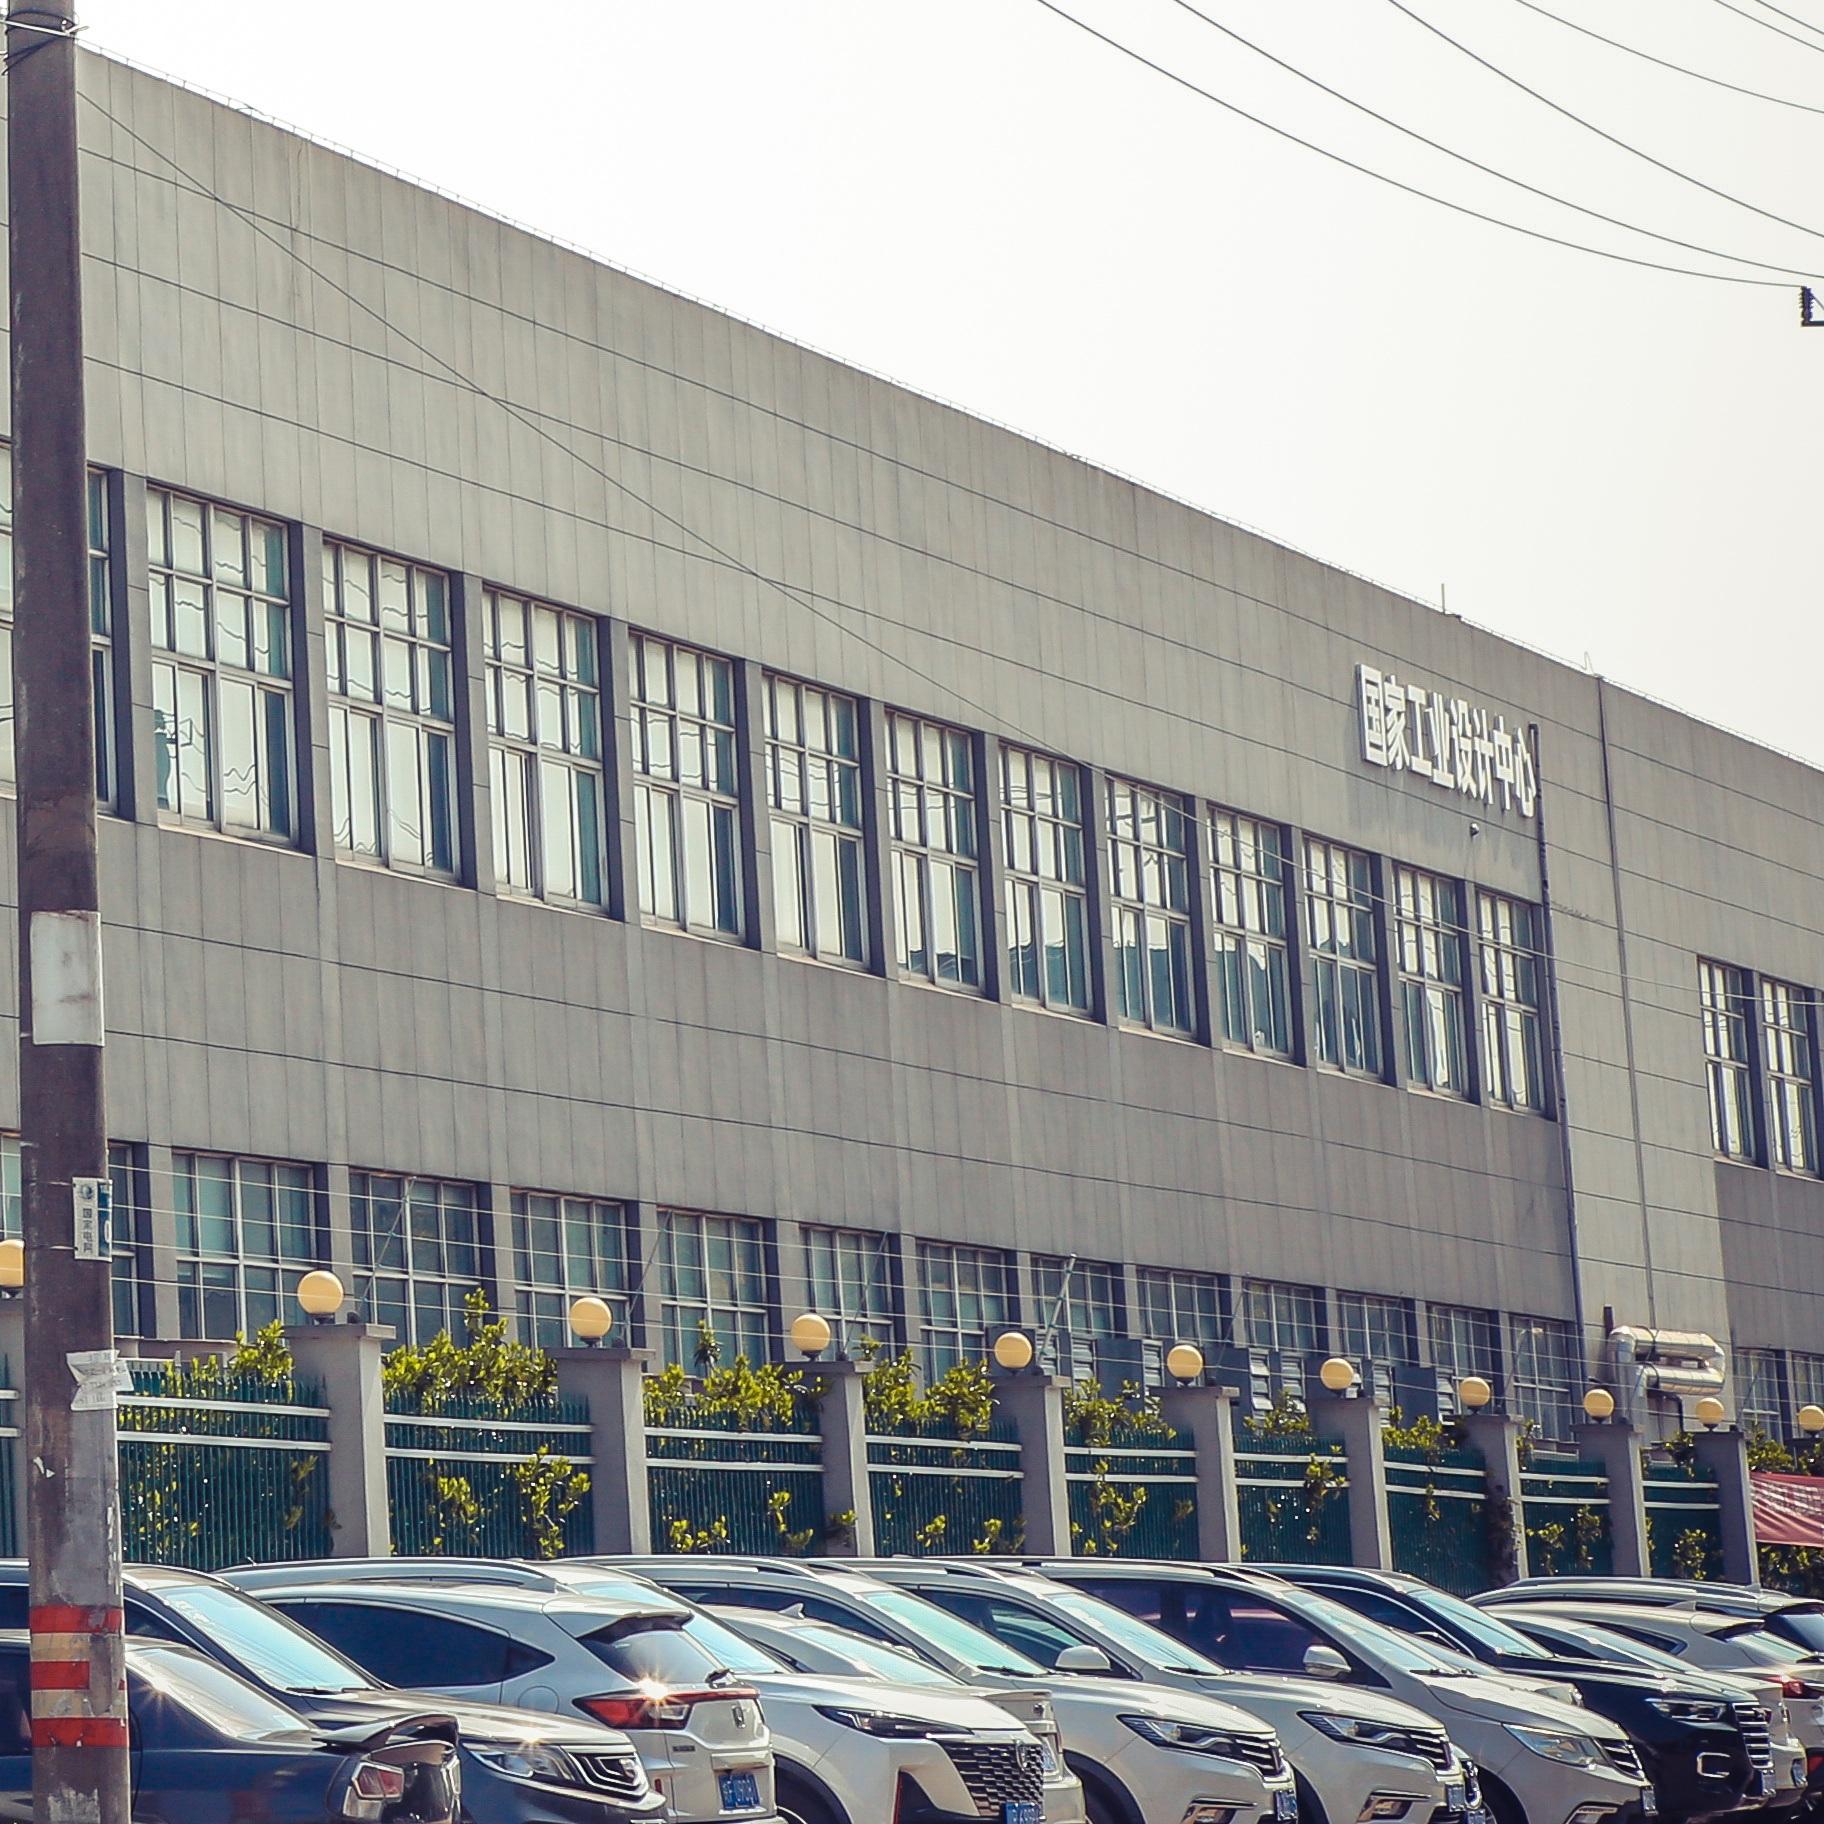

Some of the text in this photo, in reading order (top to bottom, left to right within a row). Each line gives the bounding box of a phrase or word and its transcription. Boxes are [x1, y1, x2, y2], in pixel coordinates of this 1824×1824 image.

[1356, 663, 1537, 818] 国家工业设计中心
